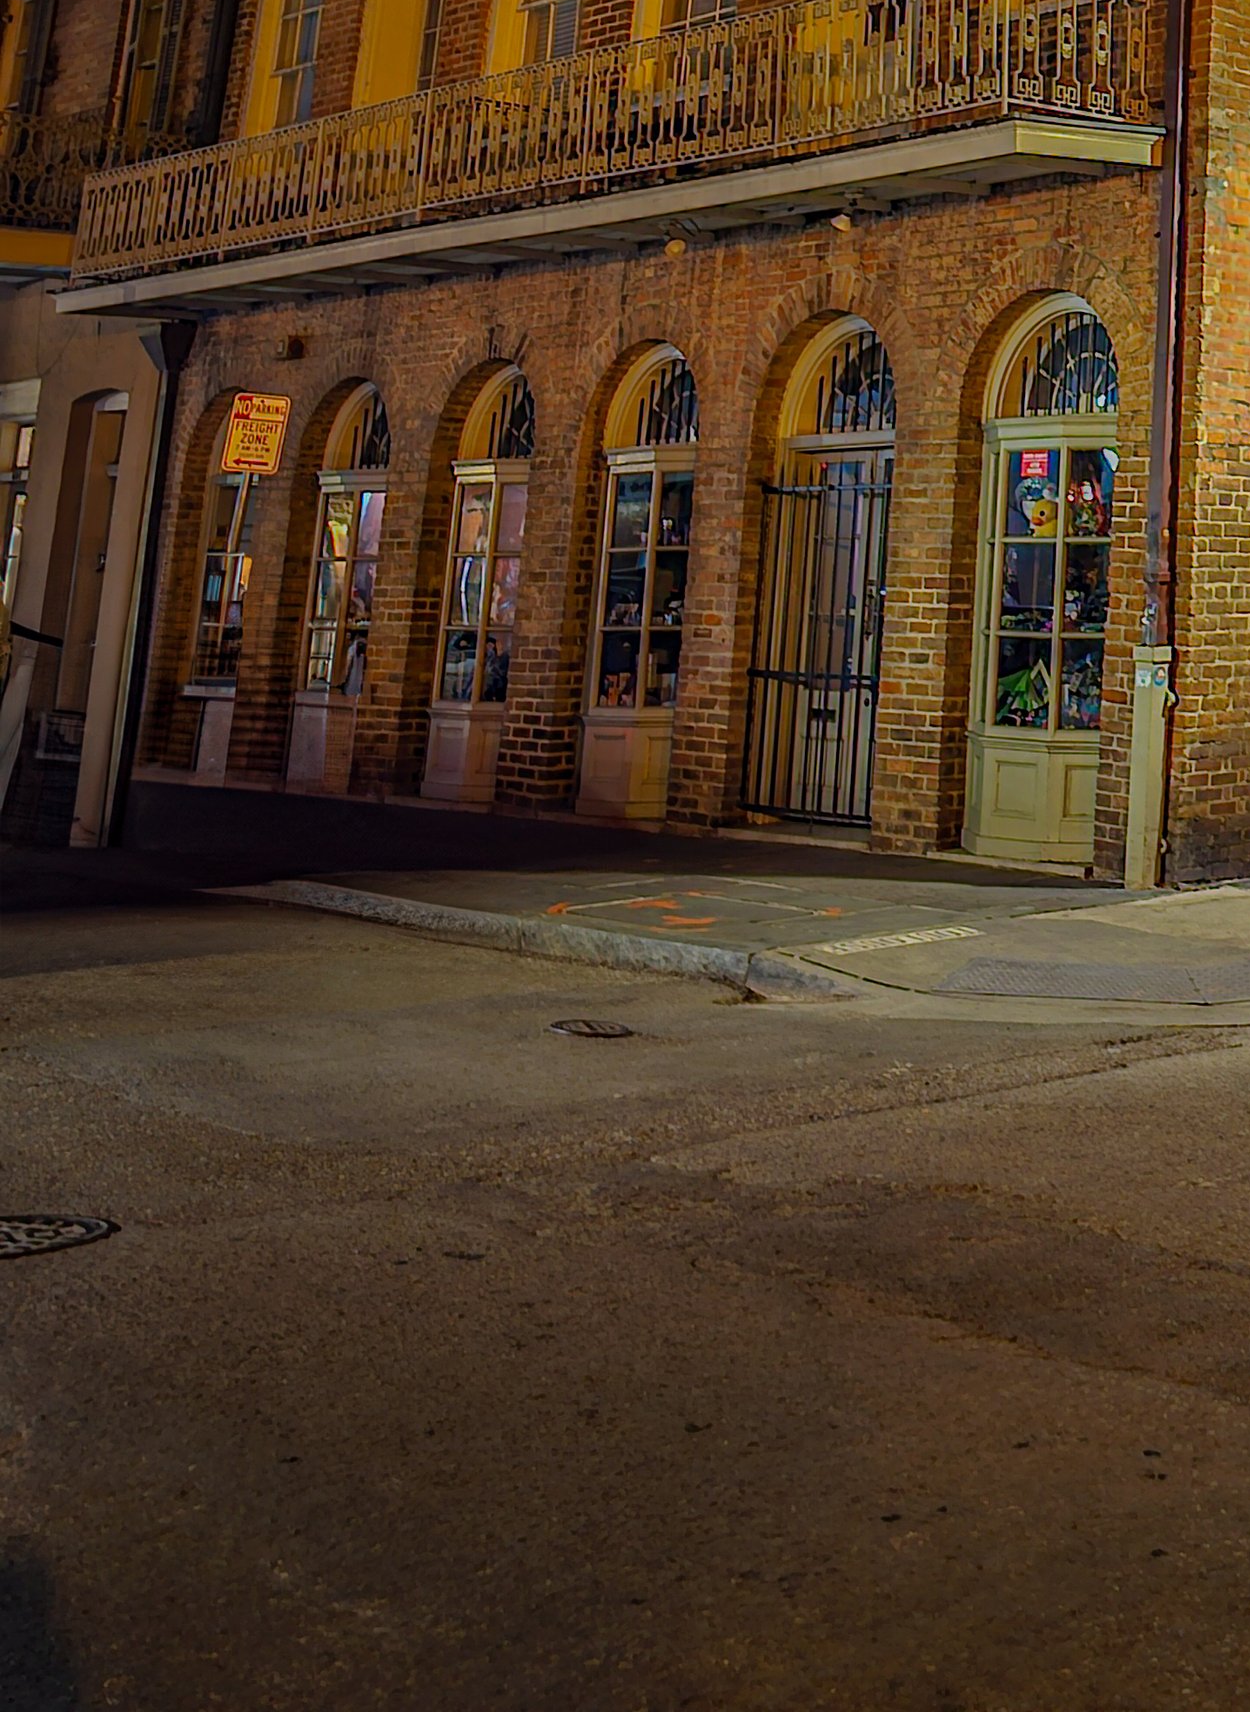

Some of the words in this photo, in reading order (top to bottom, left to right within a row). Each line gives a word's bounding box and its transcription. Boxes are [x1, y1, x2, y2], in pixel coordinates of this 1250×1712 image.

[235, 399, 252, 415] NO
[252, 403, 286, 416] PARKING
[236, 420, 279, 434] FREIGHT
[240, 433, 269, 445] ZONE
